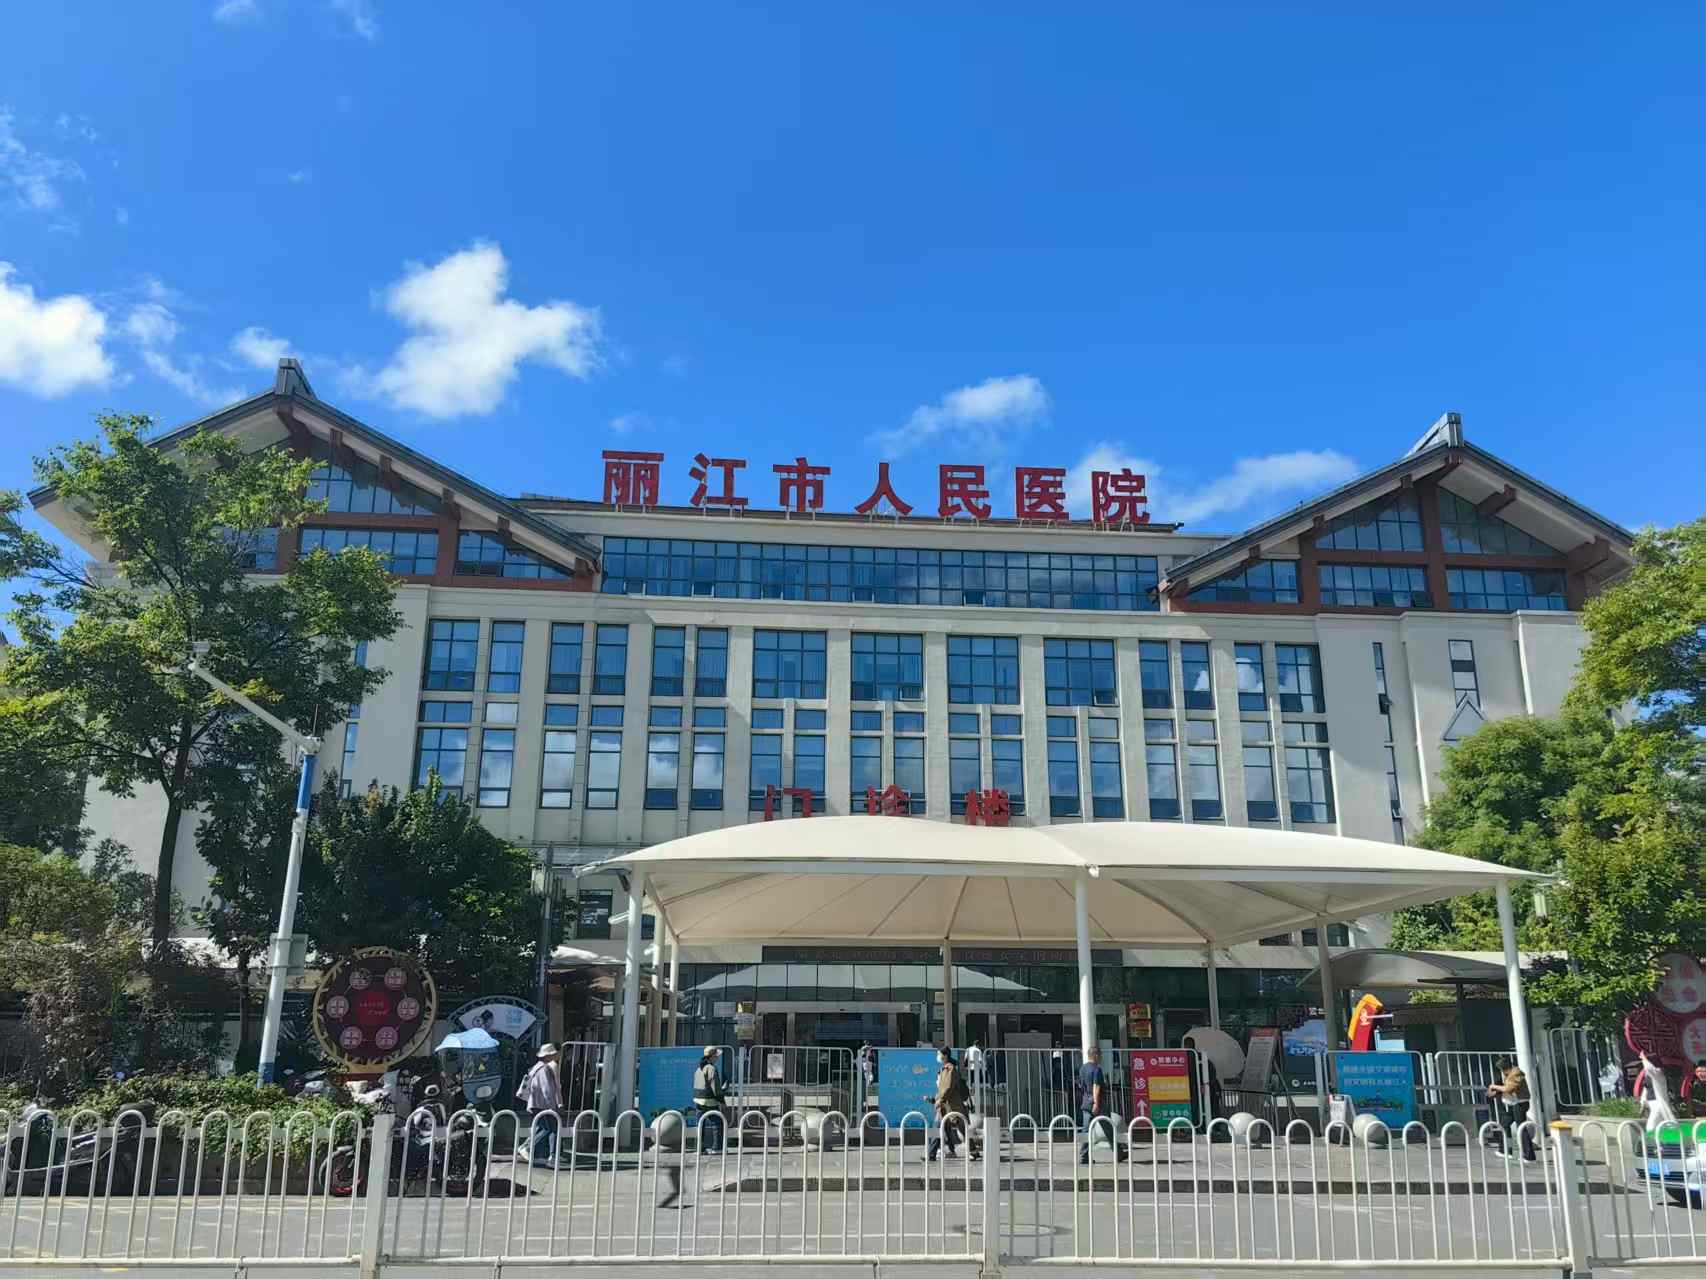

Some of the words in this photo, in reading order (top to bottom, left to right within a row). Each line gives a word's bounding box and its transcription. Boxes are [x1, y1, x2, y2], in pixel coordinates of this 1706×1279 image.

[602, 450, 1149, 524] 丽江市人民医院
[764, 784, 1009, 827] 门诊楼
